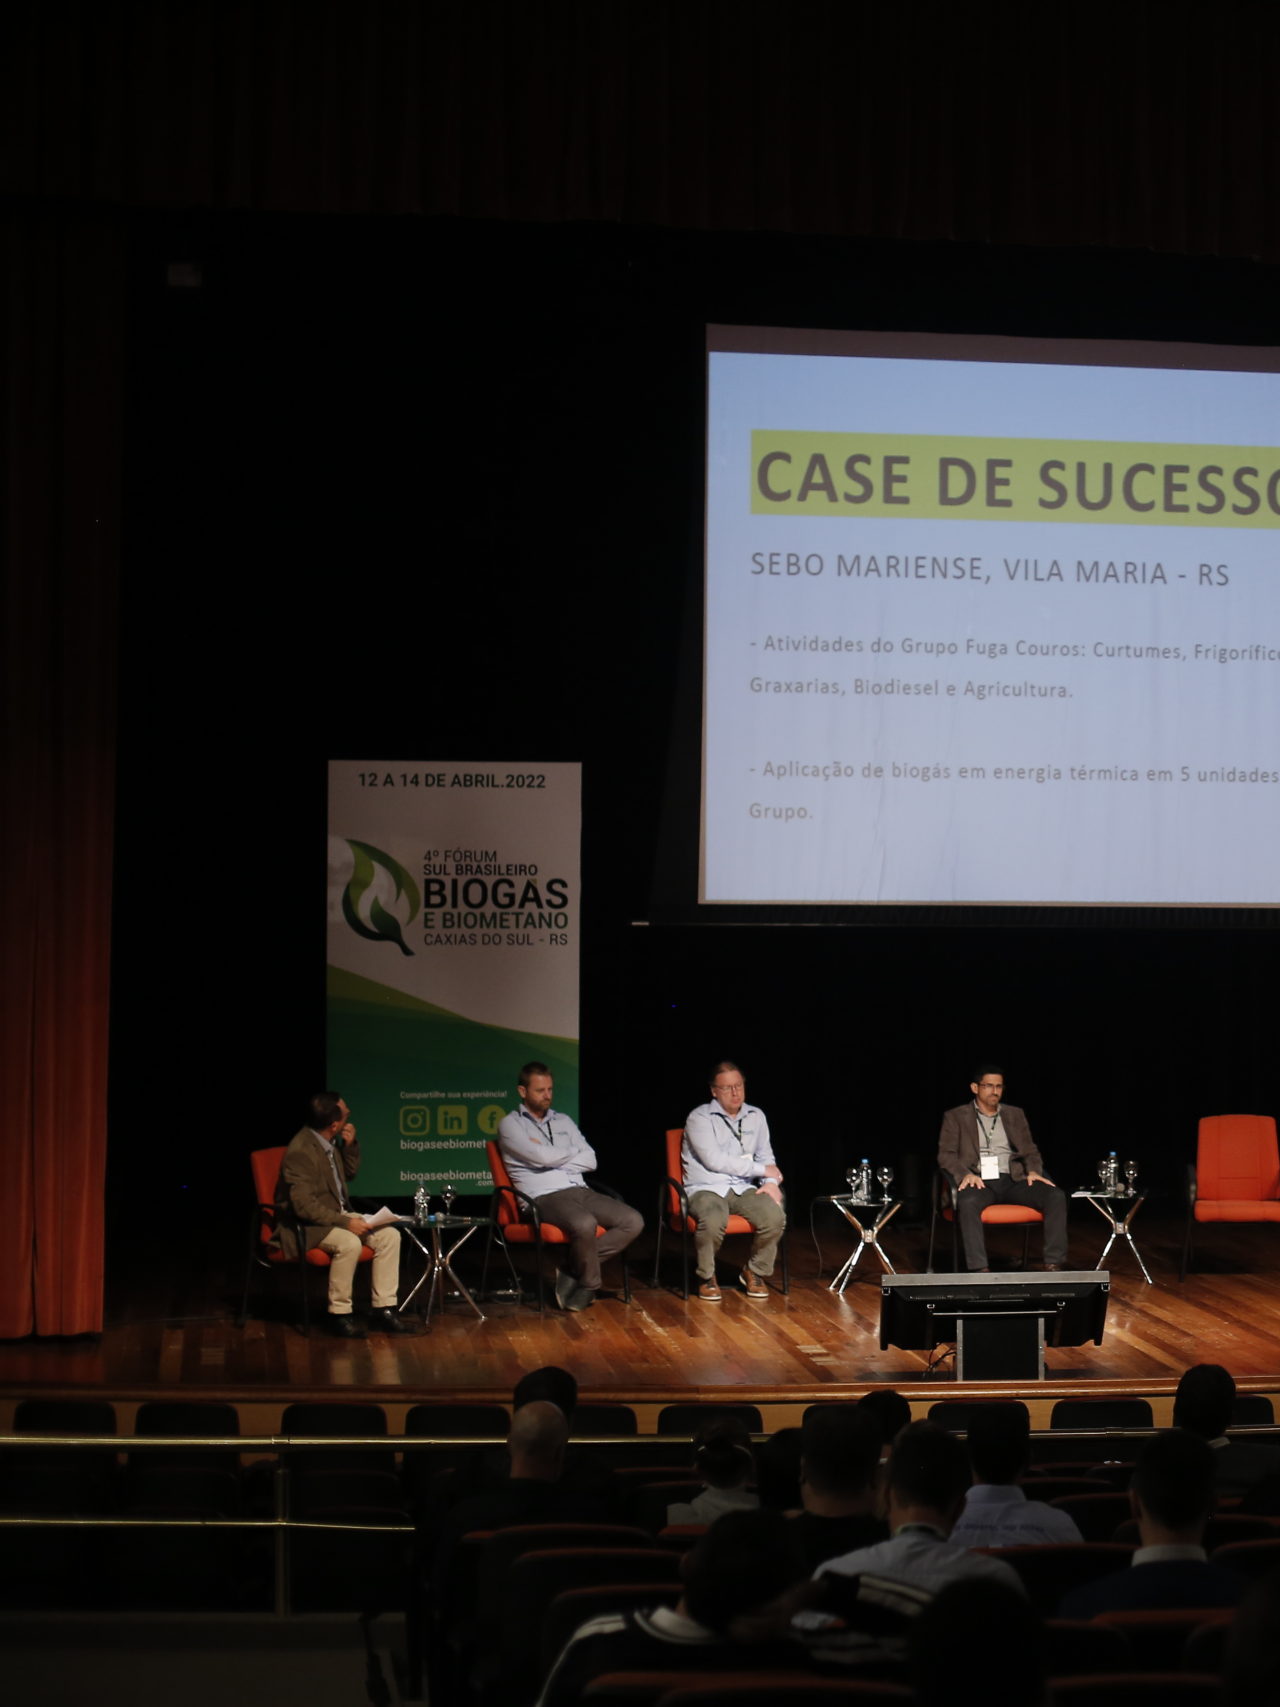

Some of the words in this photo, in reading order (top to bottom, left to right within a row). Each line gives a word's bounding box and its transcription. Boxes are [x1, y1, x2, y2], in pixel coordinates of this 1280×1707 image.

[757, 451, 910, 505] CASE
[938, 457, 1013, 508] DE
[751, 552, 824, 577] SEBO
[836, 554, 991, 585] MARIENSE,
[1003, 558, 1064, 582] VILA
[1076, 560, 1168, 585] MARIA
[1199, 564, 1229, 586] RS
[763, 635, 864, 653] Atividades
[870, 637, 895, 654] do
[901, 638, 959, 658] Grupo
[965, 639, 1009, 660] Fuga
[1015, 640, 1086, 657] Couros:
[1092, 642, 1188, 662] Curtumes,
[749, 677, 847, 697] Graxarias,
[853, 678, 939, 696] Biodiesel
[946, 684, 957, 697] e
[963, 680, 1073, 701] Agricultura.
[358, 773, 378, 787] 12
[383, 773, 395, 787] A
[400, 773, 420, 787] 14
[425, 774, 447, 788] DE
[451, 774, 546, 788] ABRIL.2022
[762, 761, 855, 782] Aplicação
[861, 763, 885, 779] de
[891, 762, 951, 783] biogás
[957, 766, 986, 780] em
[993, 764, 1062, 784] energia
[1069, 765, 1139, 782] térmica
[1146, 769, 1173, 782] em
[1180, 766, 1191, 782] 5
[1197, 767, 1279, 784] unidades
[749, 802, 814, 823] Grupo.
[444, 847, 497, 863] FÓRUM
[423, 864, 451, 876] SUL
[455, 864, 538, 876] BRASILEIRO
[424, 912, 436, 929] E
[442, 911, 569, 930] BIOMETANO
[424, 933, 478, 946] CAXIAS
[482, 933, 502, 946] DO
[507, 933, 534, 946] SUL
[549, 933, 569, 946] RS
